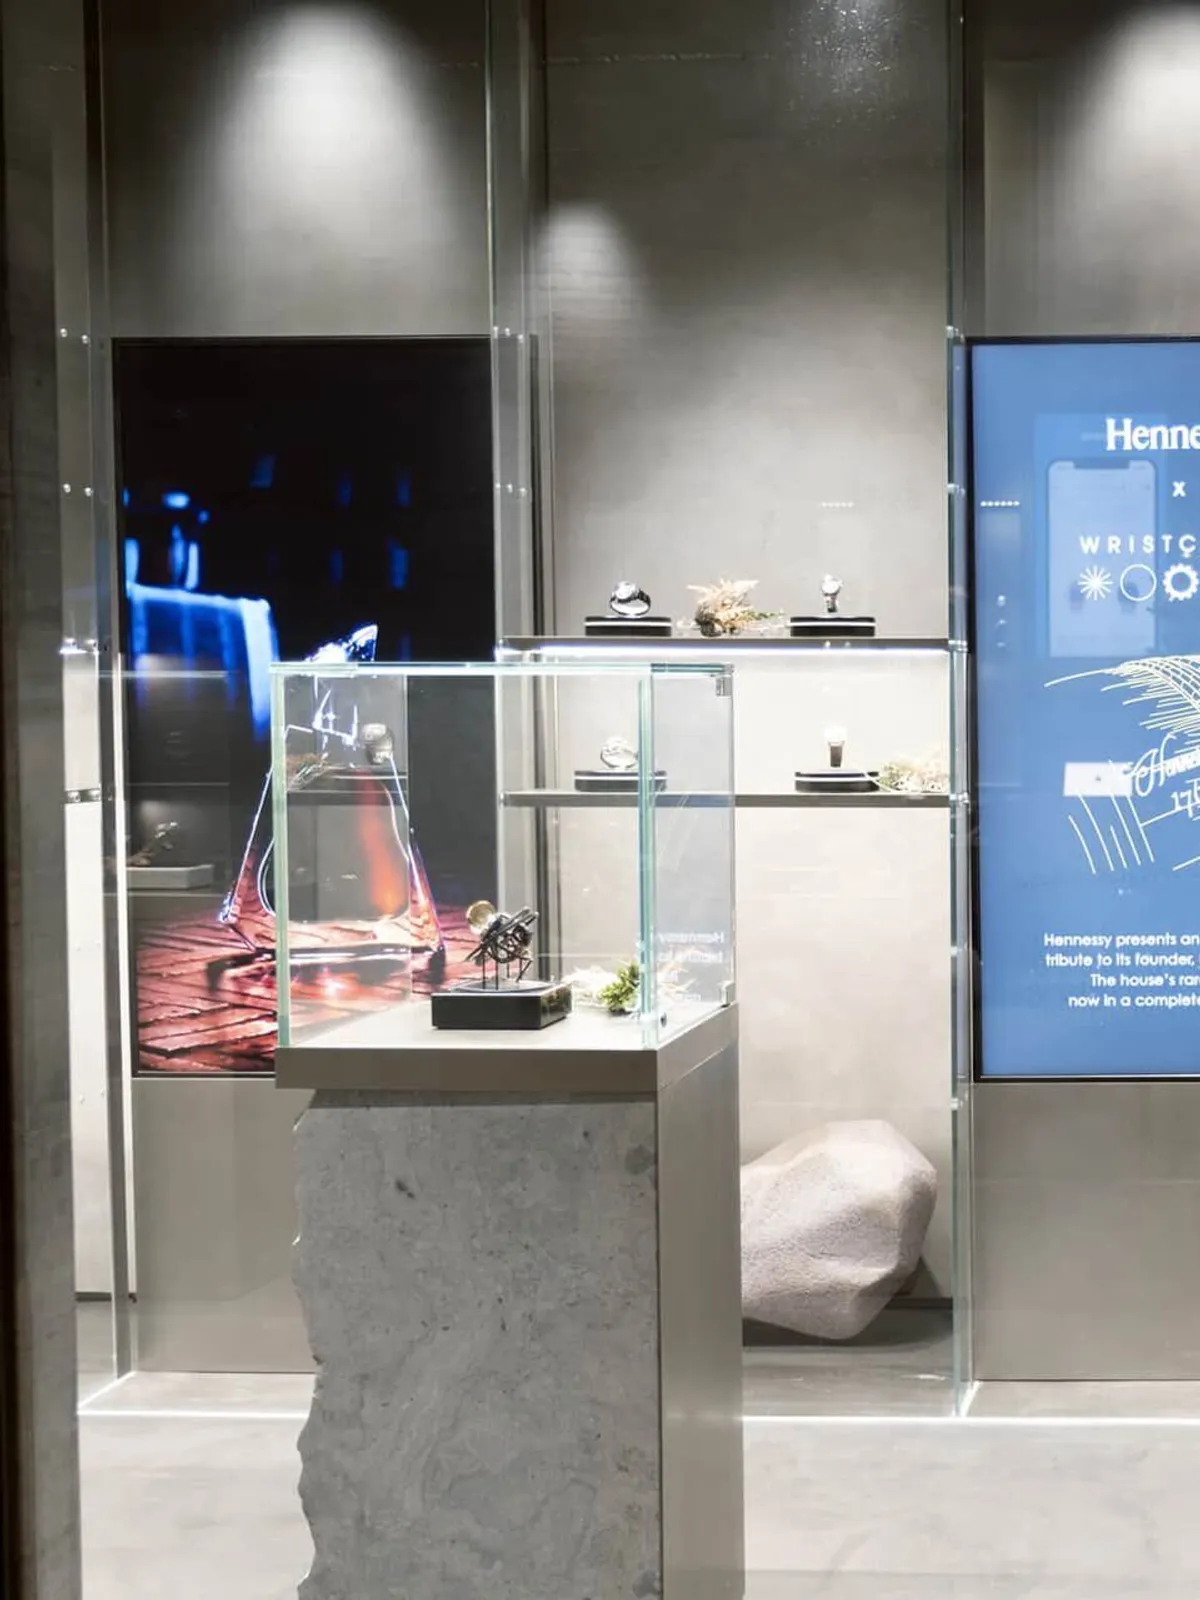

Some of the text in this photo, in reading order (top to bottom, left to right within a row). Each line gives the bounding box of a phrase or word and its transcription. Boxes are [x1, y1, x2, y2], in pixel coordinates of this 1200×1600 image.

[1044, 932, 1112, 949] Hennessy
[1115, 932, 1177, 949] presents
[1180, 934, 1200, 946] an
[1046, 953, 1093, 967] tribute
[1097, 954, 1113, 967] to
[1115, 953, 1132, 966] its
[1135, 952, 1195, 967] founder,
[1090, 973, 1116, 987] The
[1119, 973, 1176, 987] house's
[1068, 995, 1101, 1007] now
[1103, 993, 1118, 1007] in
[1120, 996, 1132, 1007] a
